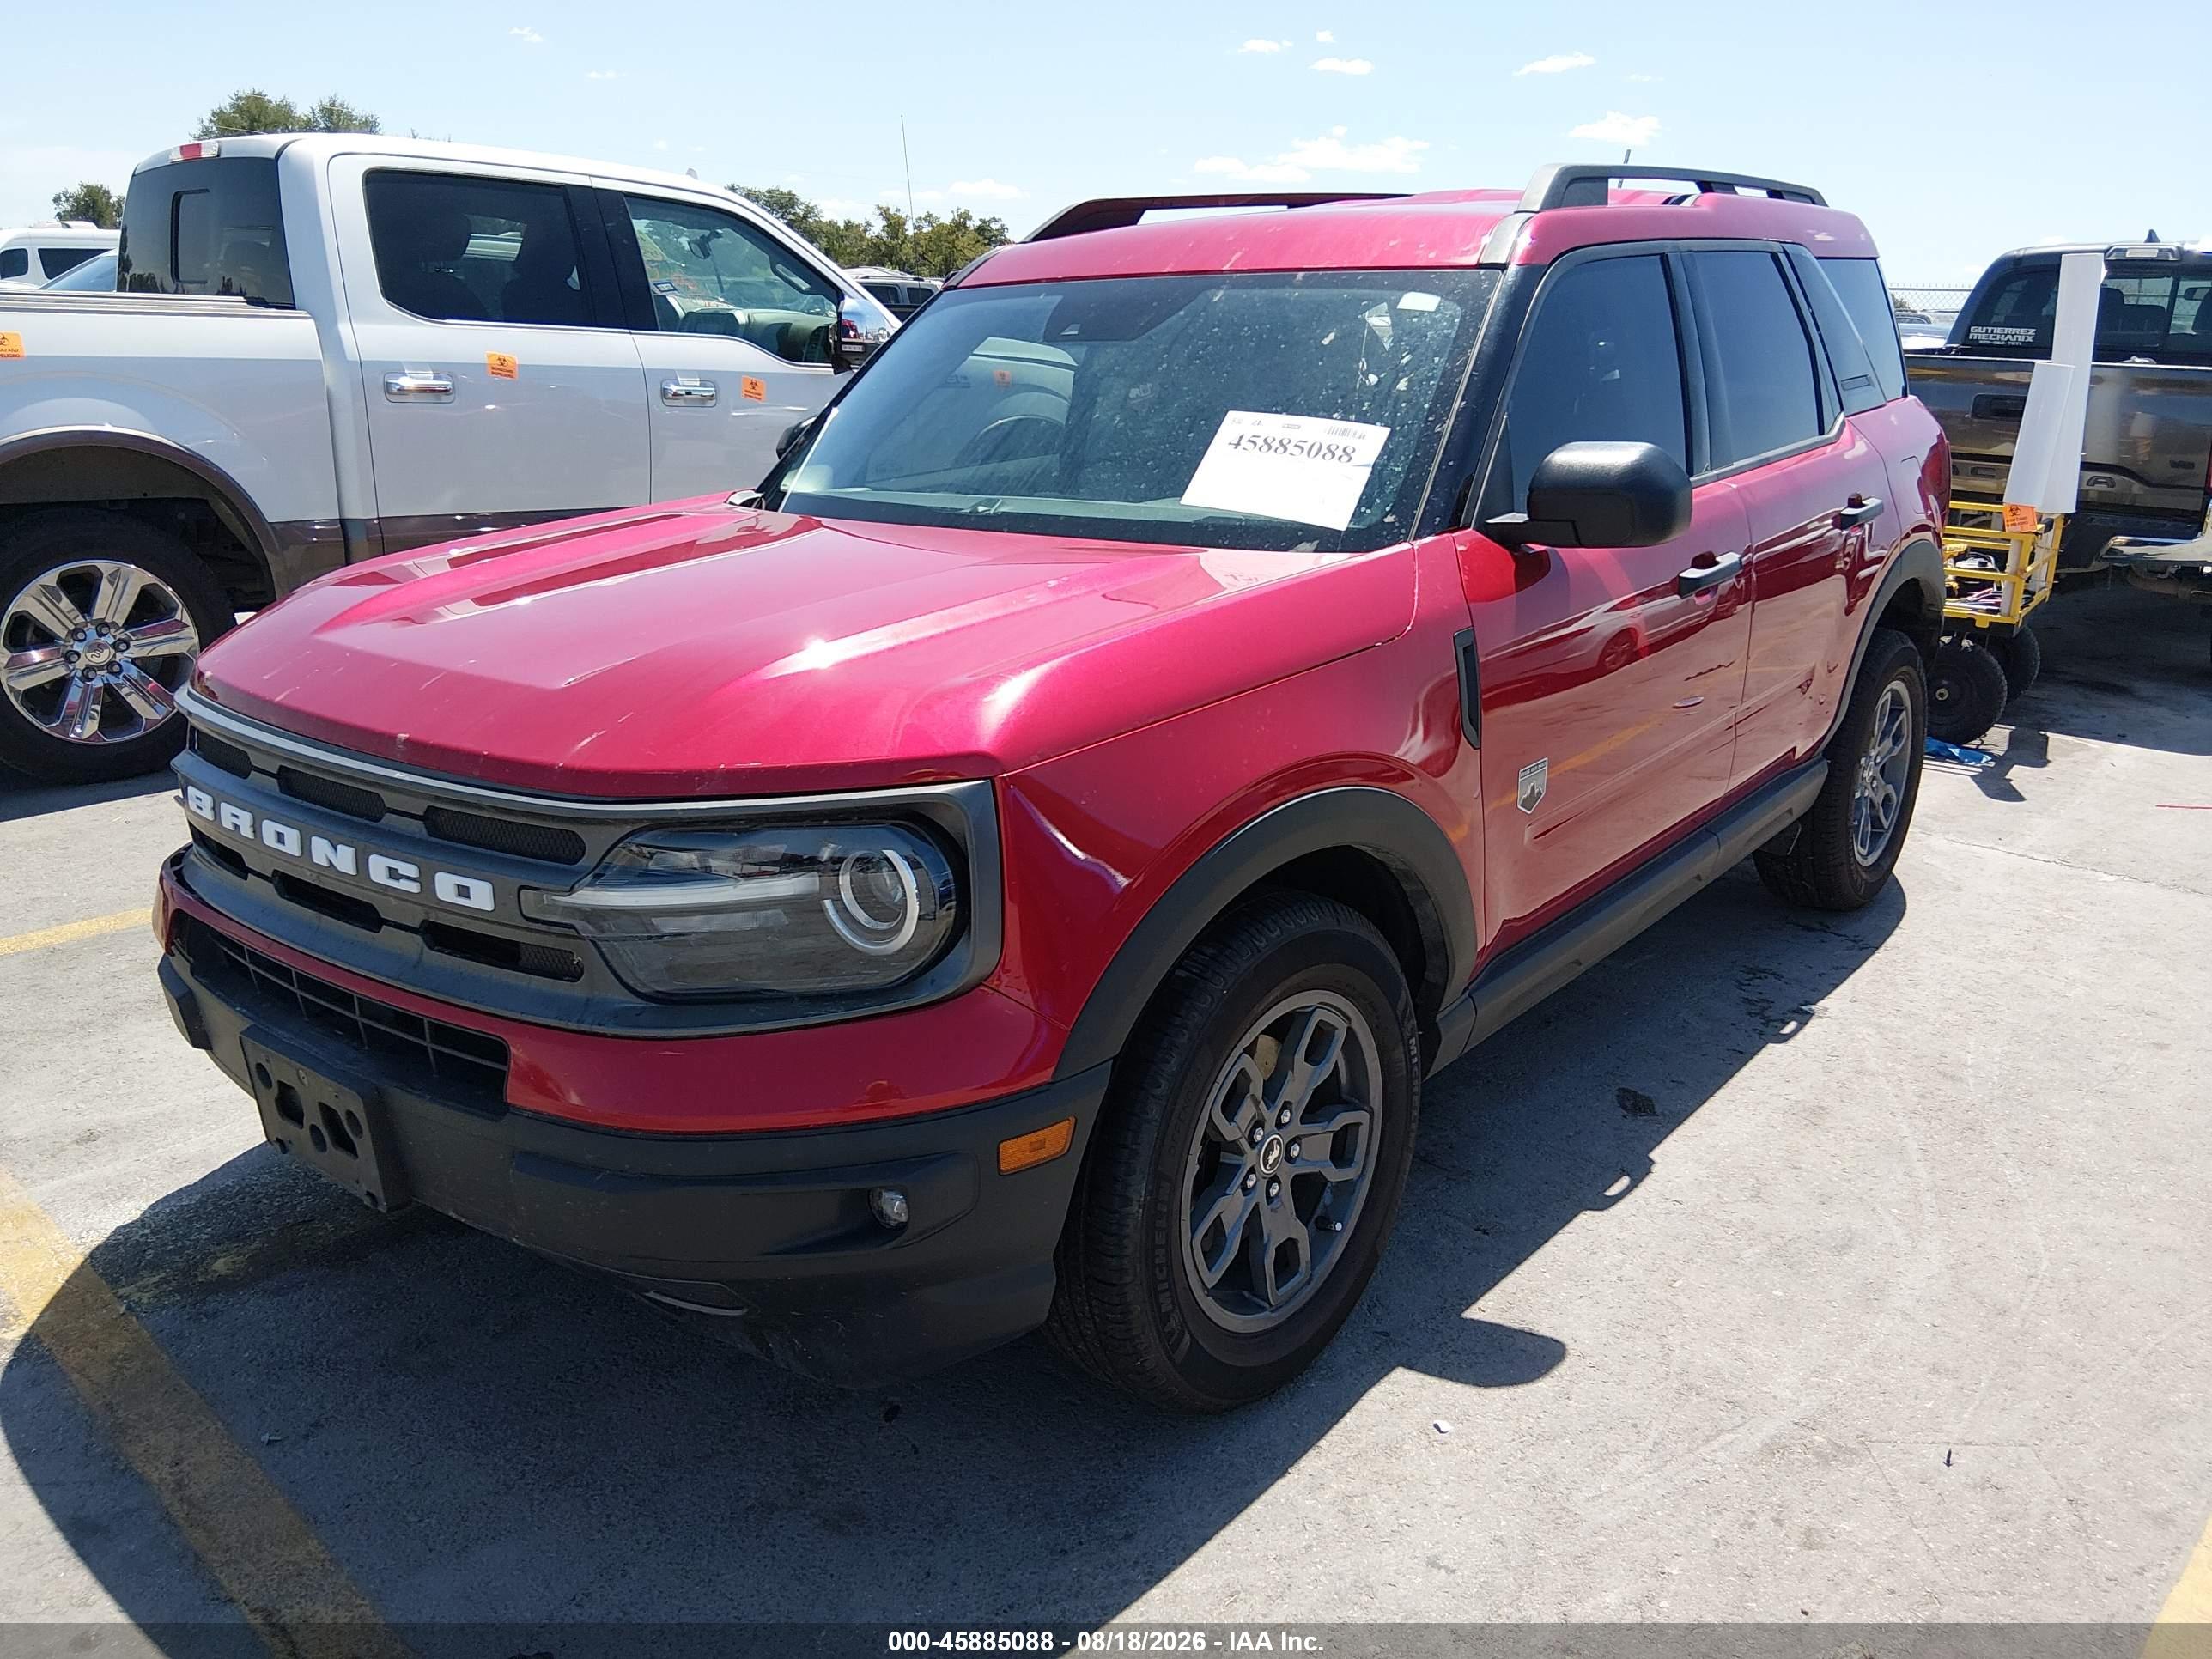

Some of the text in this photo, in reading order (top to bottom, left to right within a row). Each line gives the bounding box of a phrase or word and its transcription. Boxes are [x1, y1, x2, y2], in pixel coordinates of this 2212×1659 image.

[1969, 333, 2034, 342] MECHANIX
[1970, 326, 2036, 336] GUTIERREZ
[1228, 434, 1356, 464] 45885088
[187, 785, 495, 911] BRONCO
[1154, 1181, 1174, 1313] MICHELIN
